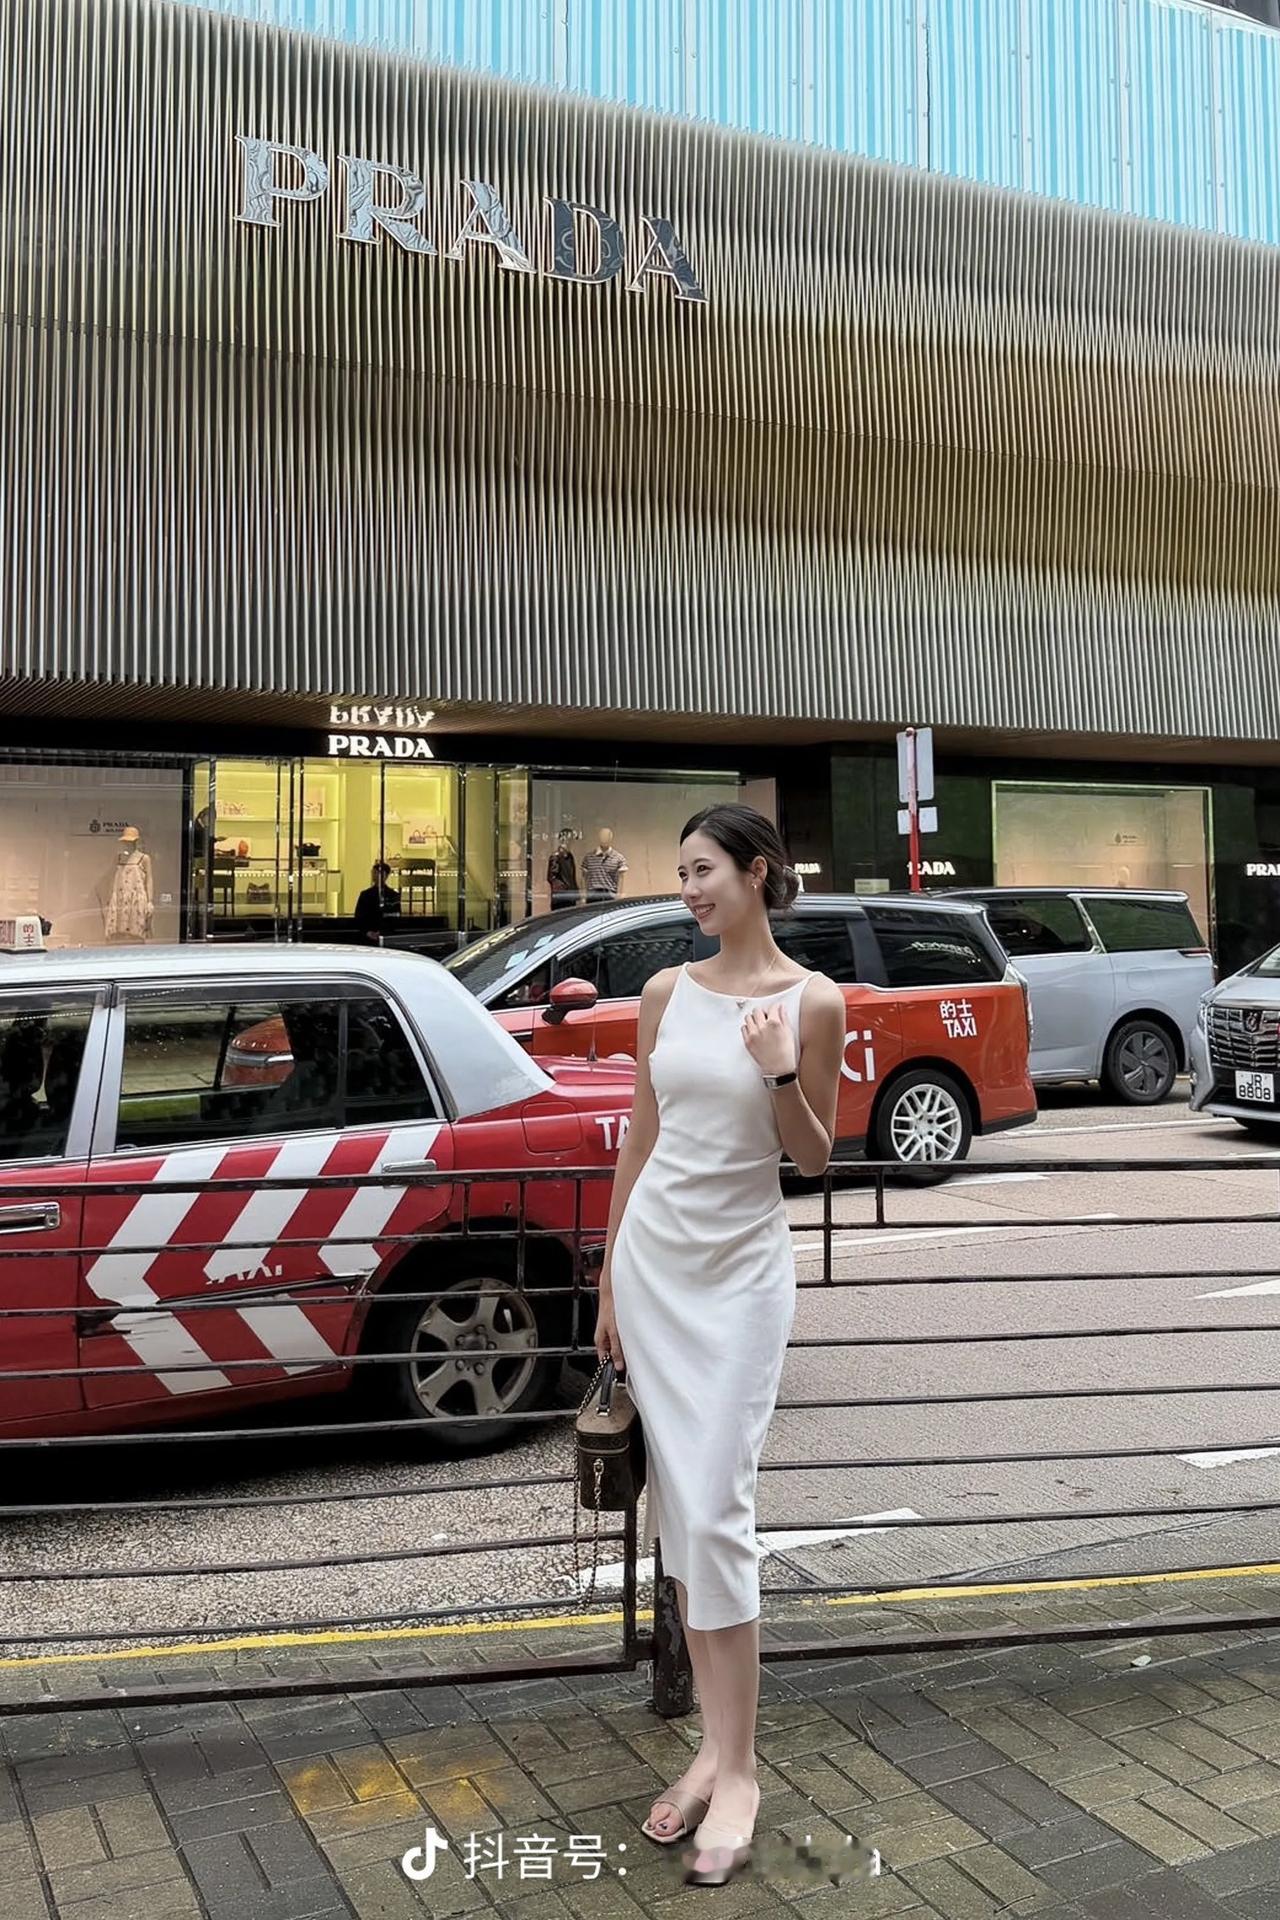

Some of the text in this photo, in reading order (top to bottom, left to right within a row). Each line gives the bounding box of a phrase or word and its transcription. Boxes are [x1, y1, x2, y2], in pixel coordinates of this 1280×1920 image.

[234, 134, 708, 303] PRADA
[328, 735, 434, 758] PRADA
[940, 999, 973, 1018] 的士
[943, 1018, 977, 1038] TAXI
[1246, 1074, 1262, 1087] JR
[1239, 1085, 1271, 1100] 8808
